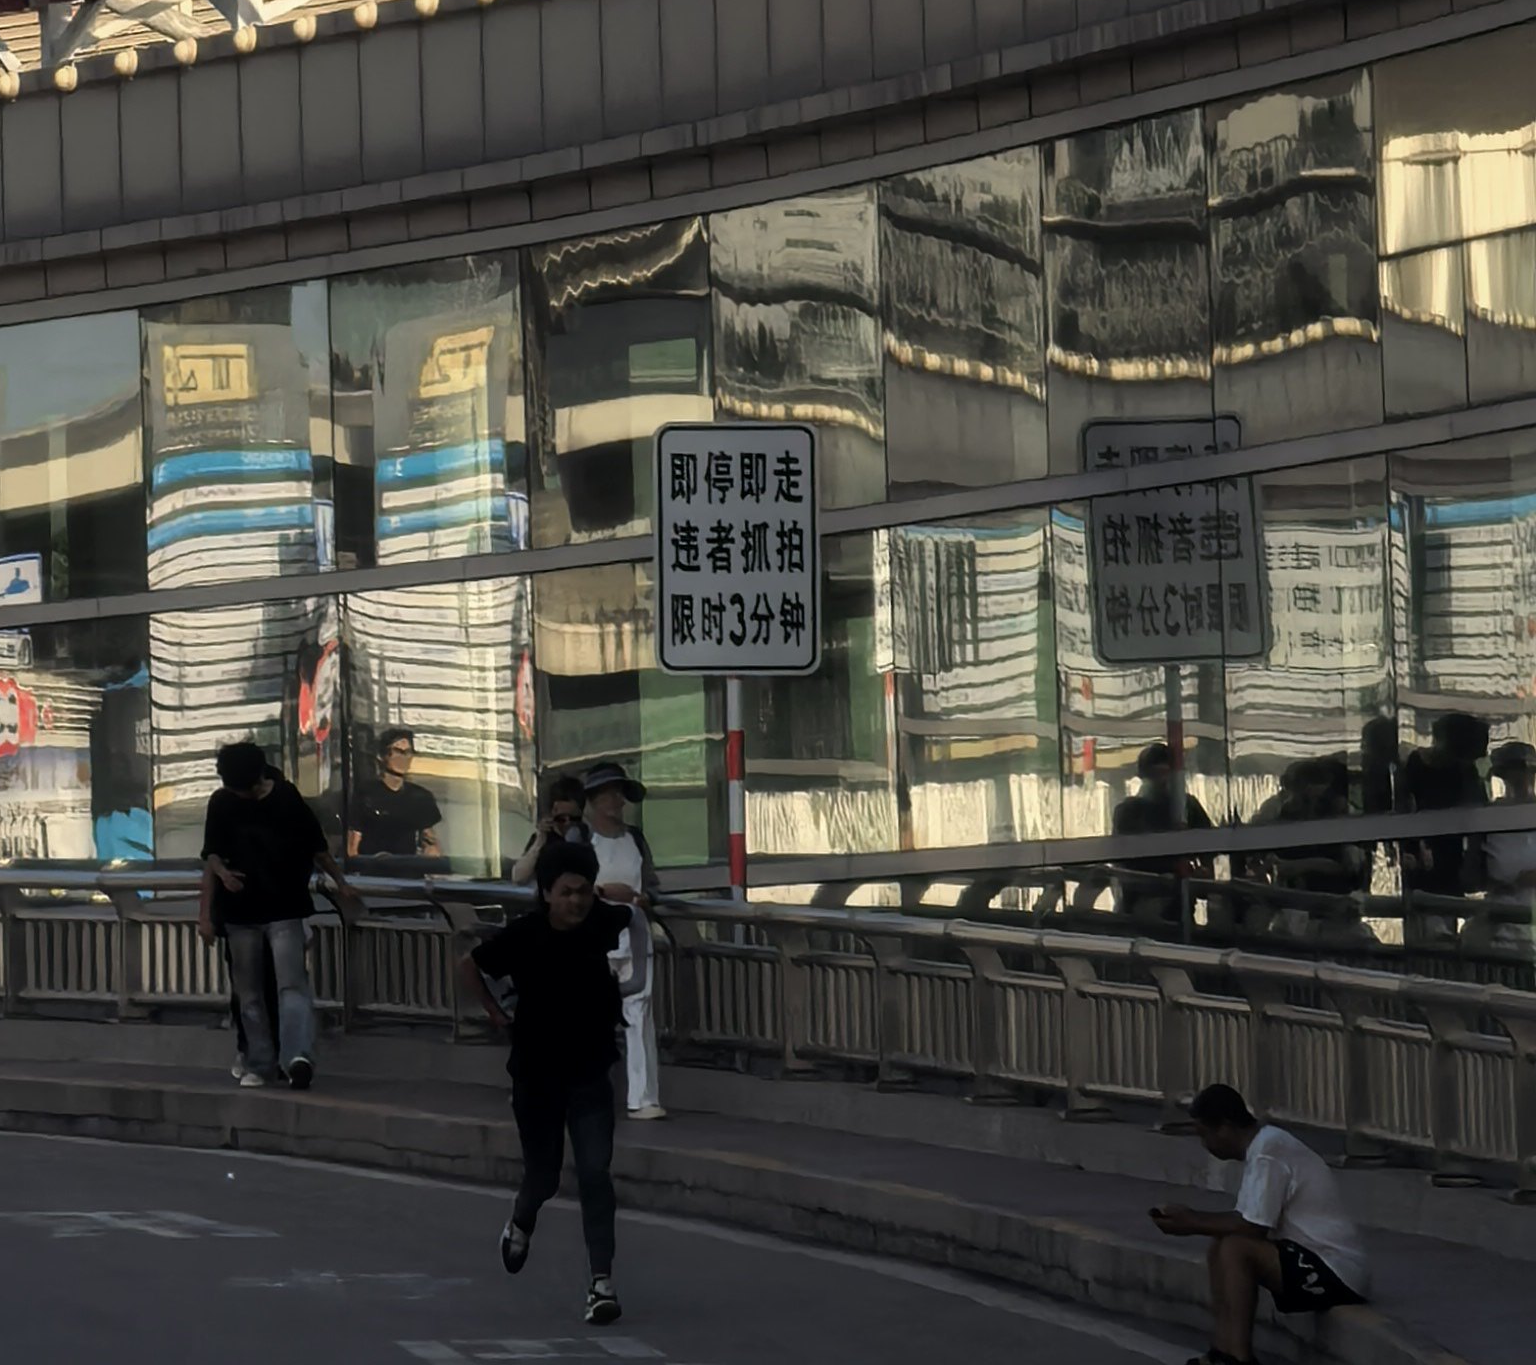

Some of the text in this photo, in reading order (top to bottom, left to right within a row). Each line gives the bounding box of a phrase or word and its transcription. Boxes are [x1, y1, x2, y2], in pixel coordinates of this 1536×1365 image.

[670, 450, 803, 504] 即停即走
[671, 519, 805, 574] 违者抓拍
[670, 592, 806, 647] 限时3分钟
